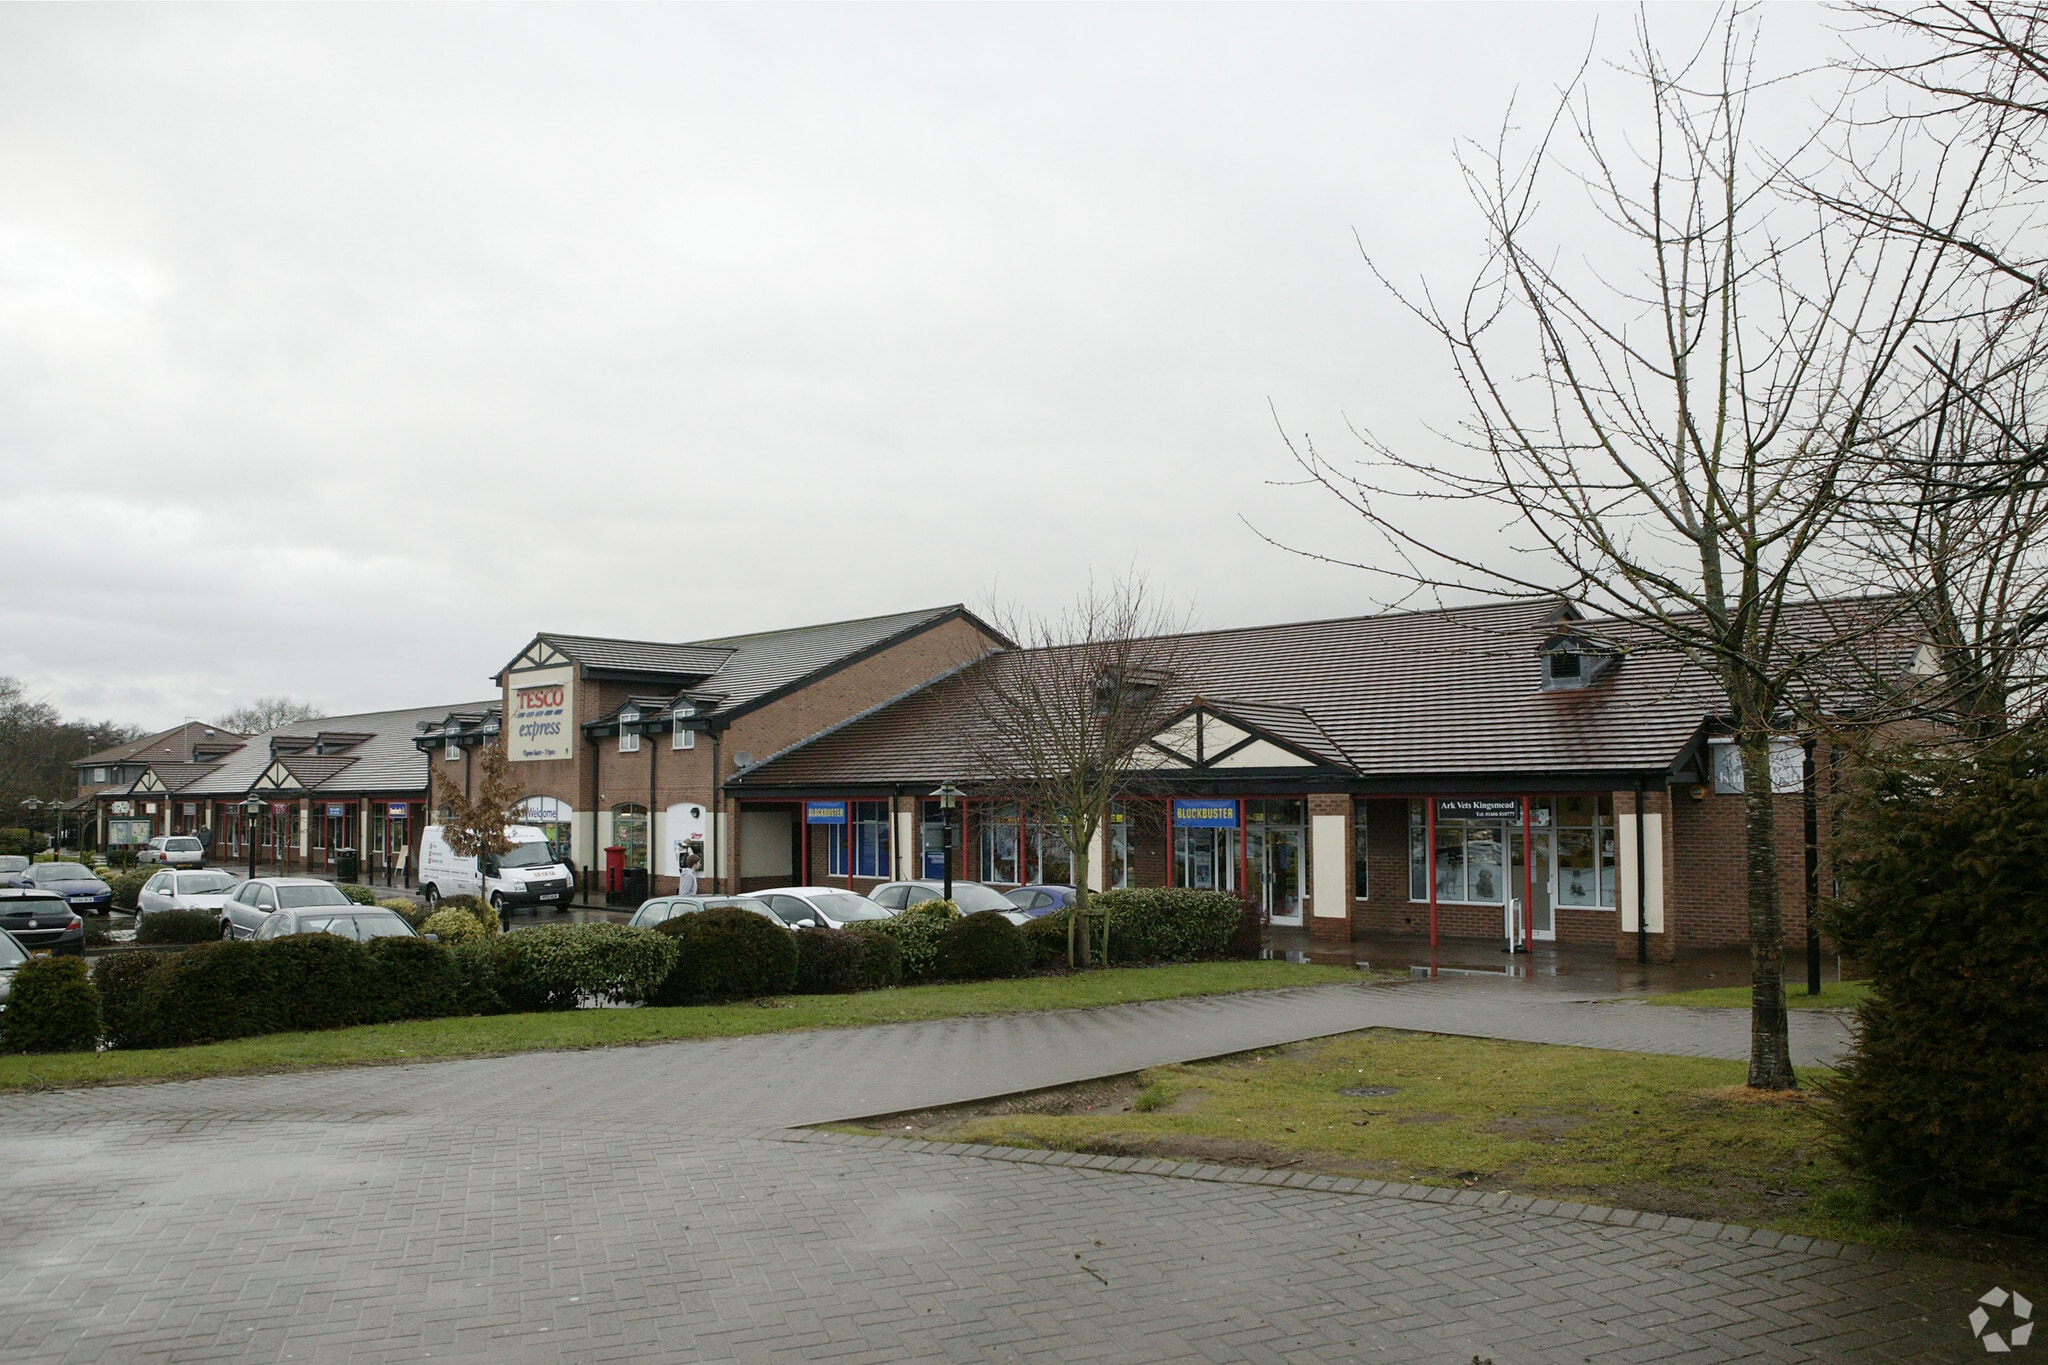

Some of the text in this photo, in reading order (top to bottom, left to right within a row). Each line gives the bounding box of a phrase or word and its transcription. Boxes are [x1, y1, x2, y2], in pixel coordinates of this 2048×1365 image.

[516, 687, 565, 709] TESCO
[519, 721, 561, 741] express
[1457, 801, 1472, 809] Vets
[1473, 801, 1514, 810] Kingsmead
[528, 808, 556, 818] Welcome
[808, 808, 844, 817] BLOCKBUSTER
[1177, 808, 1234, 819] BLOCKBUSTER
